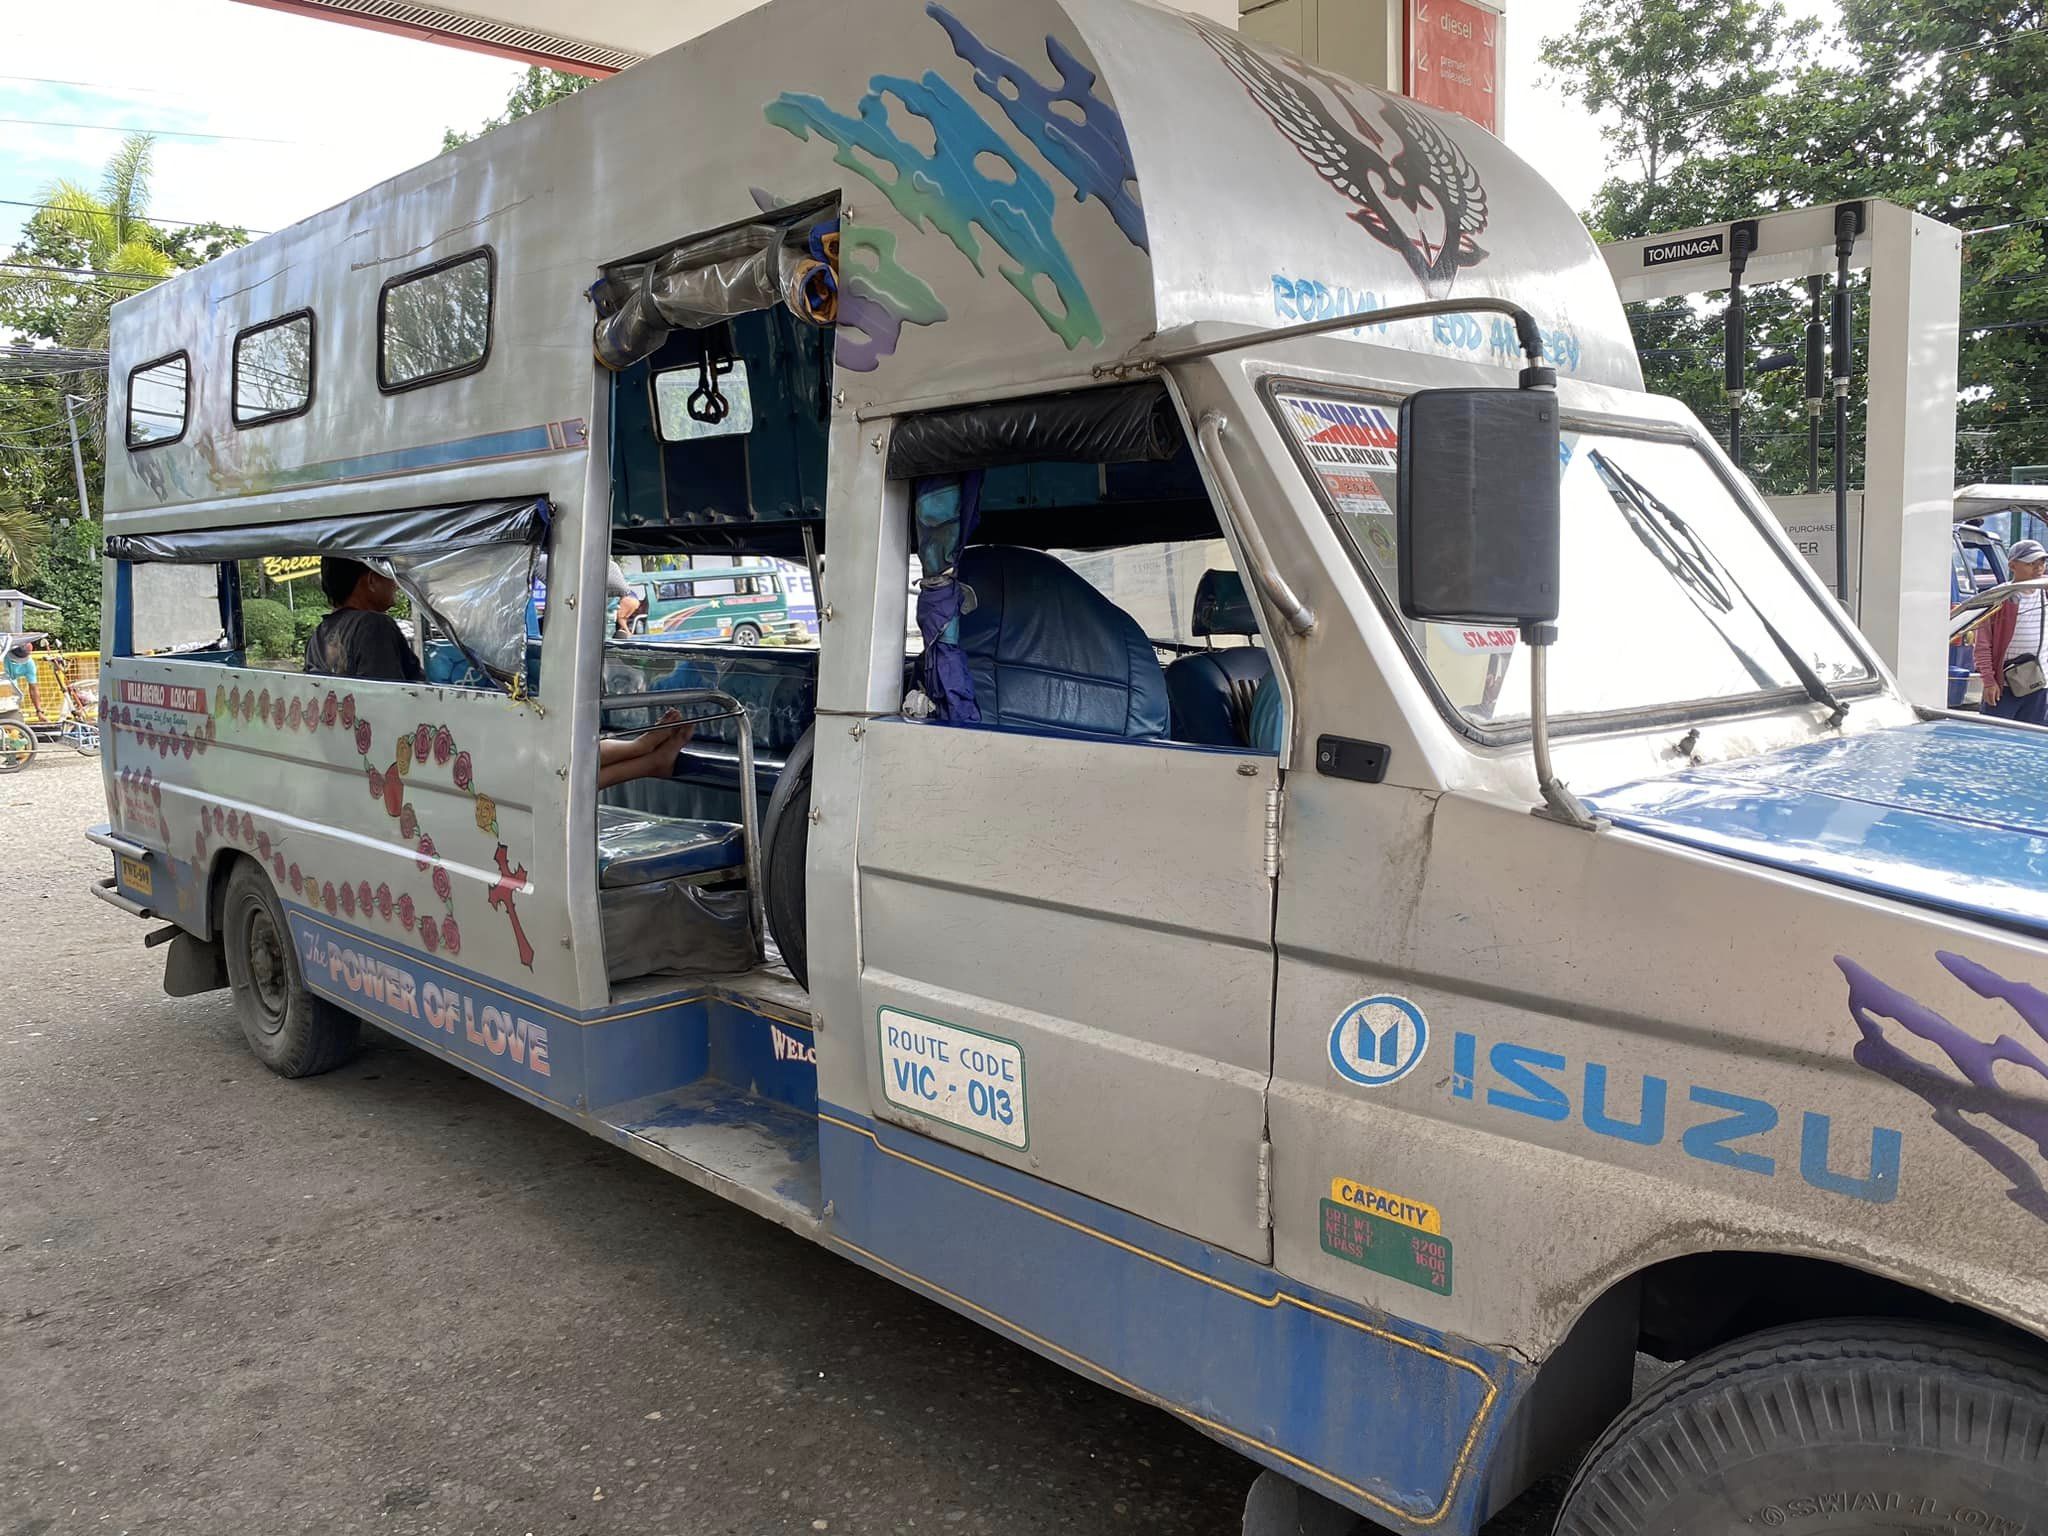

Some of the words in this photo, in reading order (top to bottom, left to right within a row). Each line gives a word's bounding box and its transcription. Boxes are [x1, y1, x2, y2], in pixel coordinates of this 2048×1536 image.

[1440, 13, 1472, 39] diesel
[1648, 239, 1719, 262] TOMINAGA
[1432, 314, 1482, 350] ROD
[1307, 444, 1345, 463] VILLA
[1344, 447, 1390, 466] BAYBAY
[1789, 524, 1836, 534] PURCHASE
[303, 931, 328, 968] The
[327, 941, 420, 1019] POWER
[422, 981, 461, 1034] OF
[463, 996, 551, 1077] LOVE
[888, 1026, 949, 1063] ROUTE
[960, 1048, 1014, 1082] CODE
[893, 1058, 938, 1101] VIC
[968, 1079, 1013, 1126] 013
[1452, 1031, 1901, 1202] ISUZU
[1342, 1184, 1428, 1225] CAPACITY
[1431, 1271, 1445, 1288] 21
